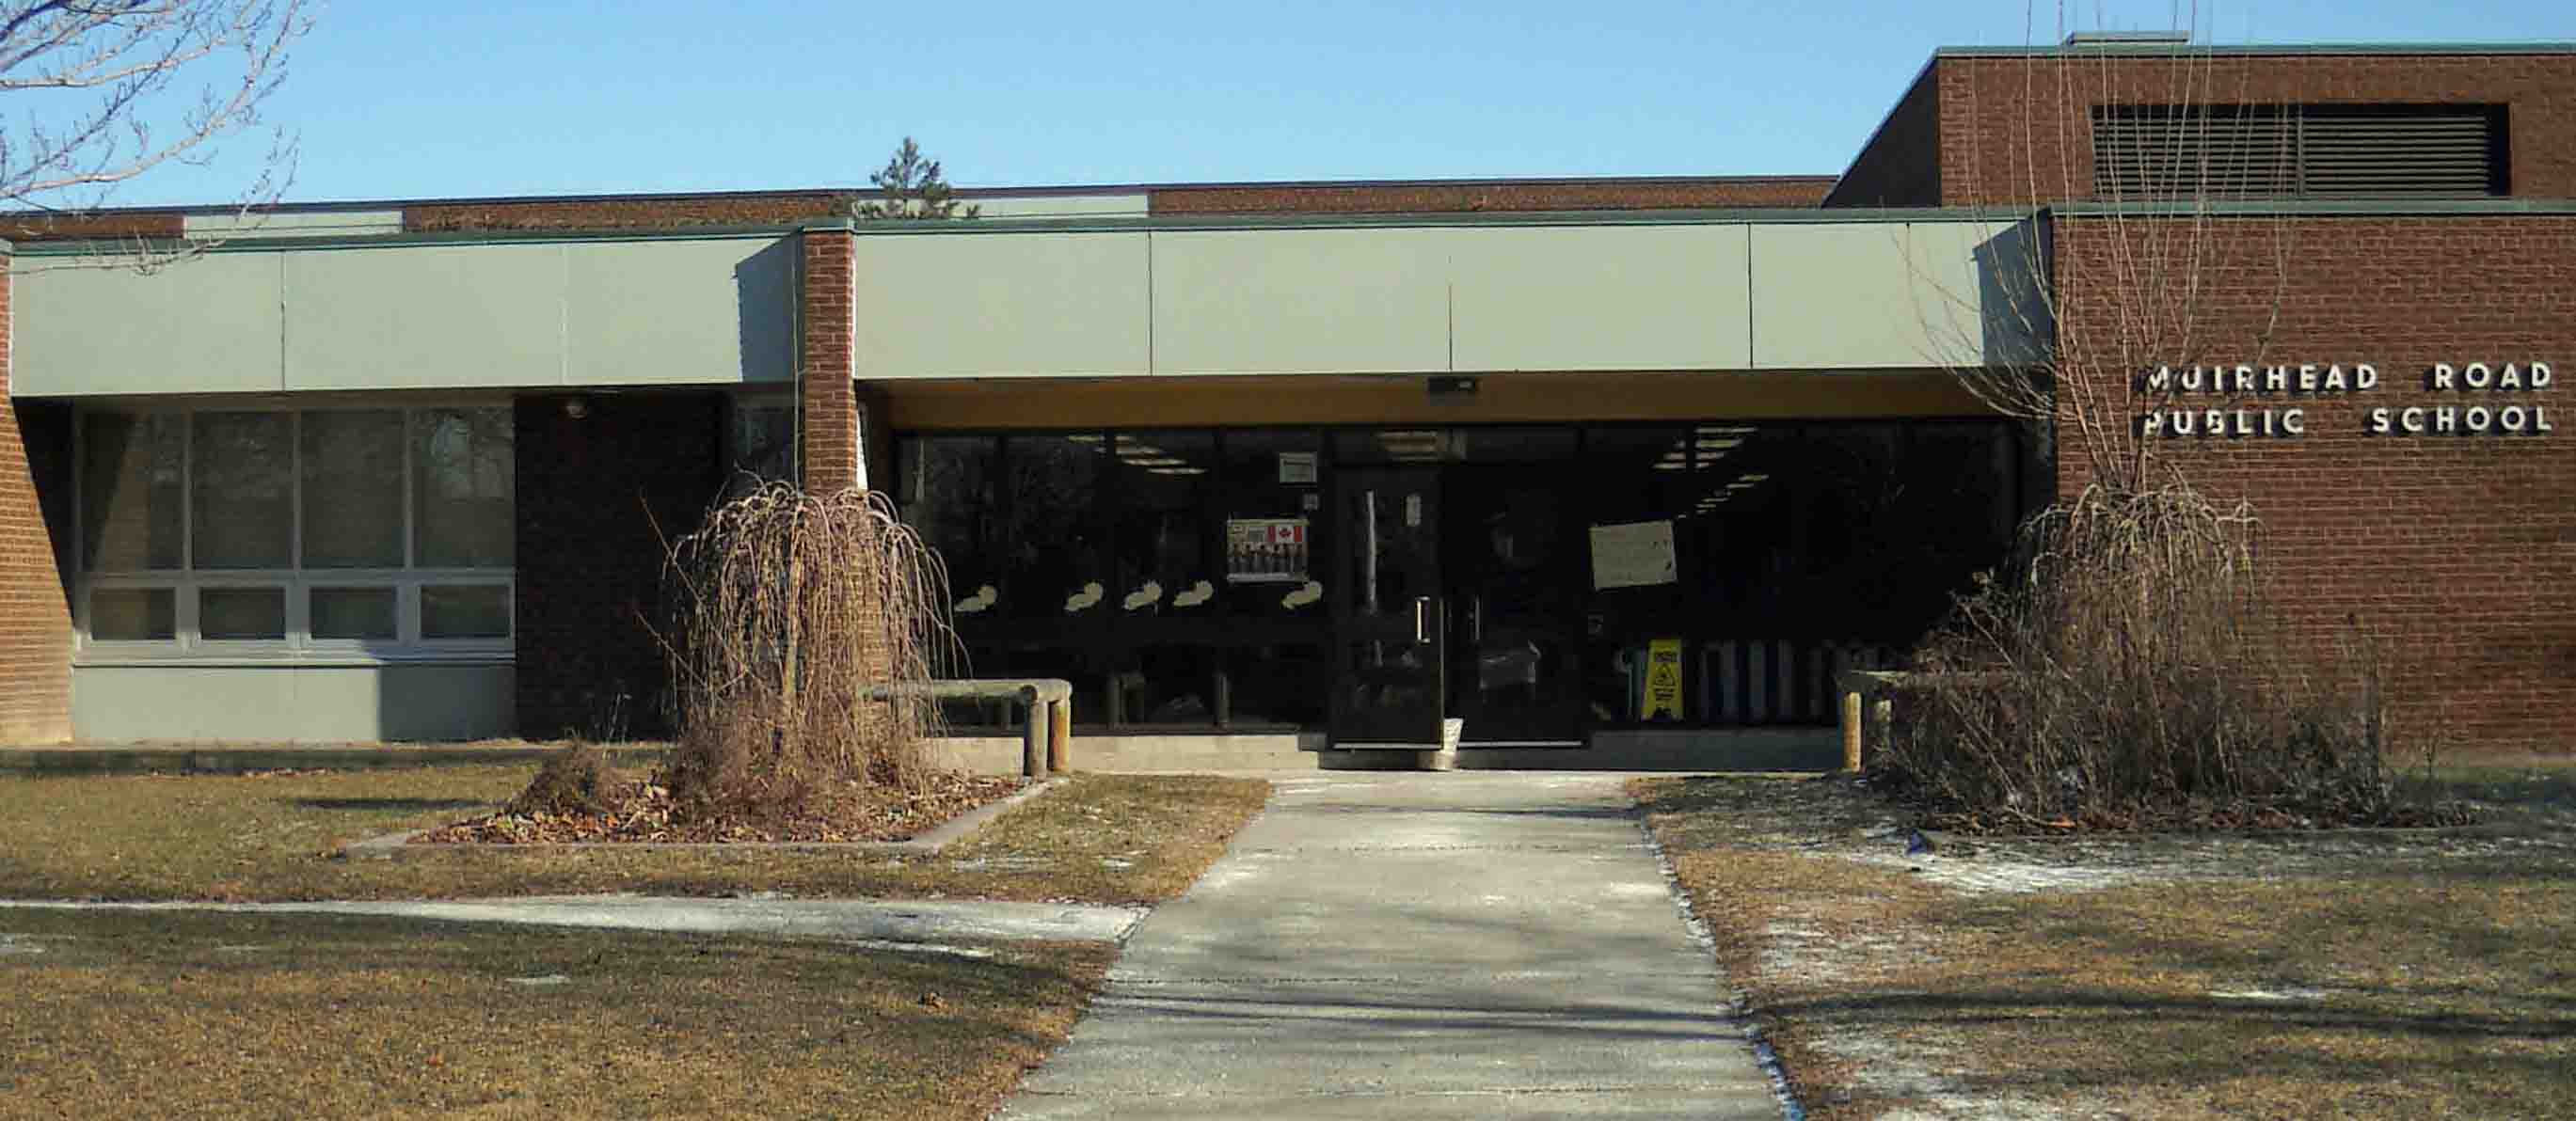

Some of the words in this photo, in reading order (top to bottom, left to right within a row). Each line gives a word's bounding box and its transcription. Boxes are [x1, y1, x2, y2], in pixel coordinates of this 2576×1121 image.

[2148, 364, 2378, 389] MUIRHEAD
[2435, 362, 2552, 387] ROAD
[2371, 405, 2552, 433] SCHOOL
